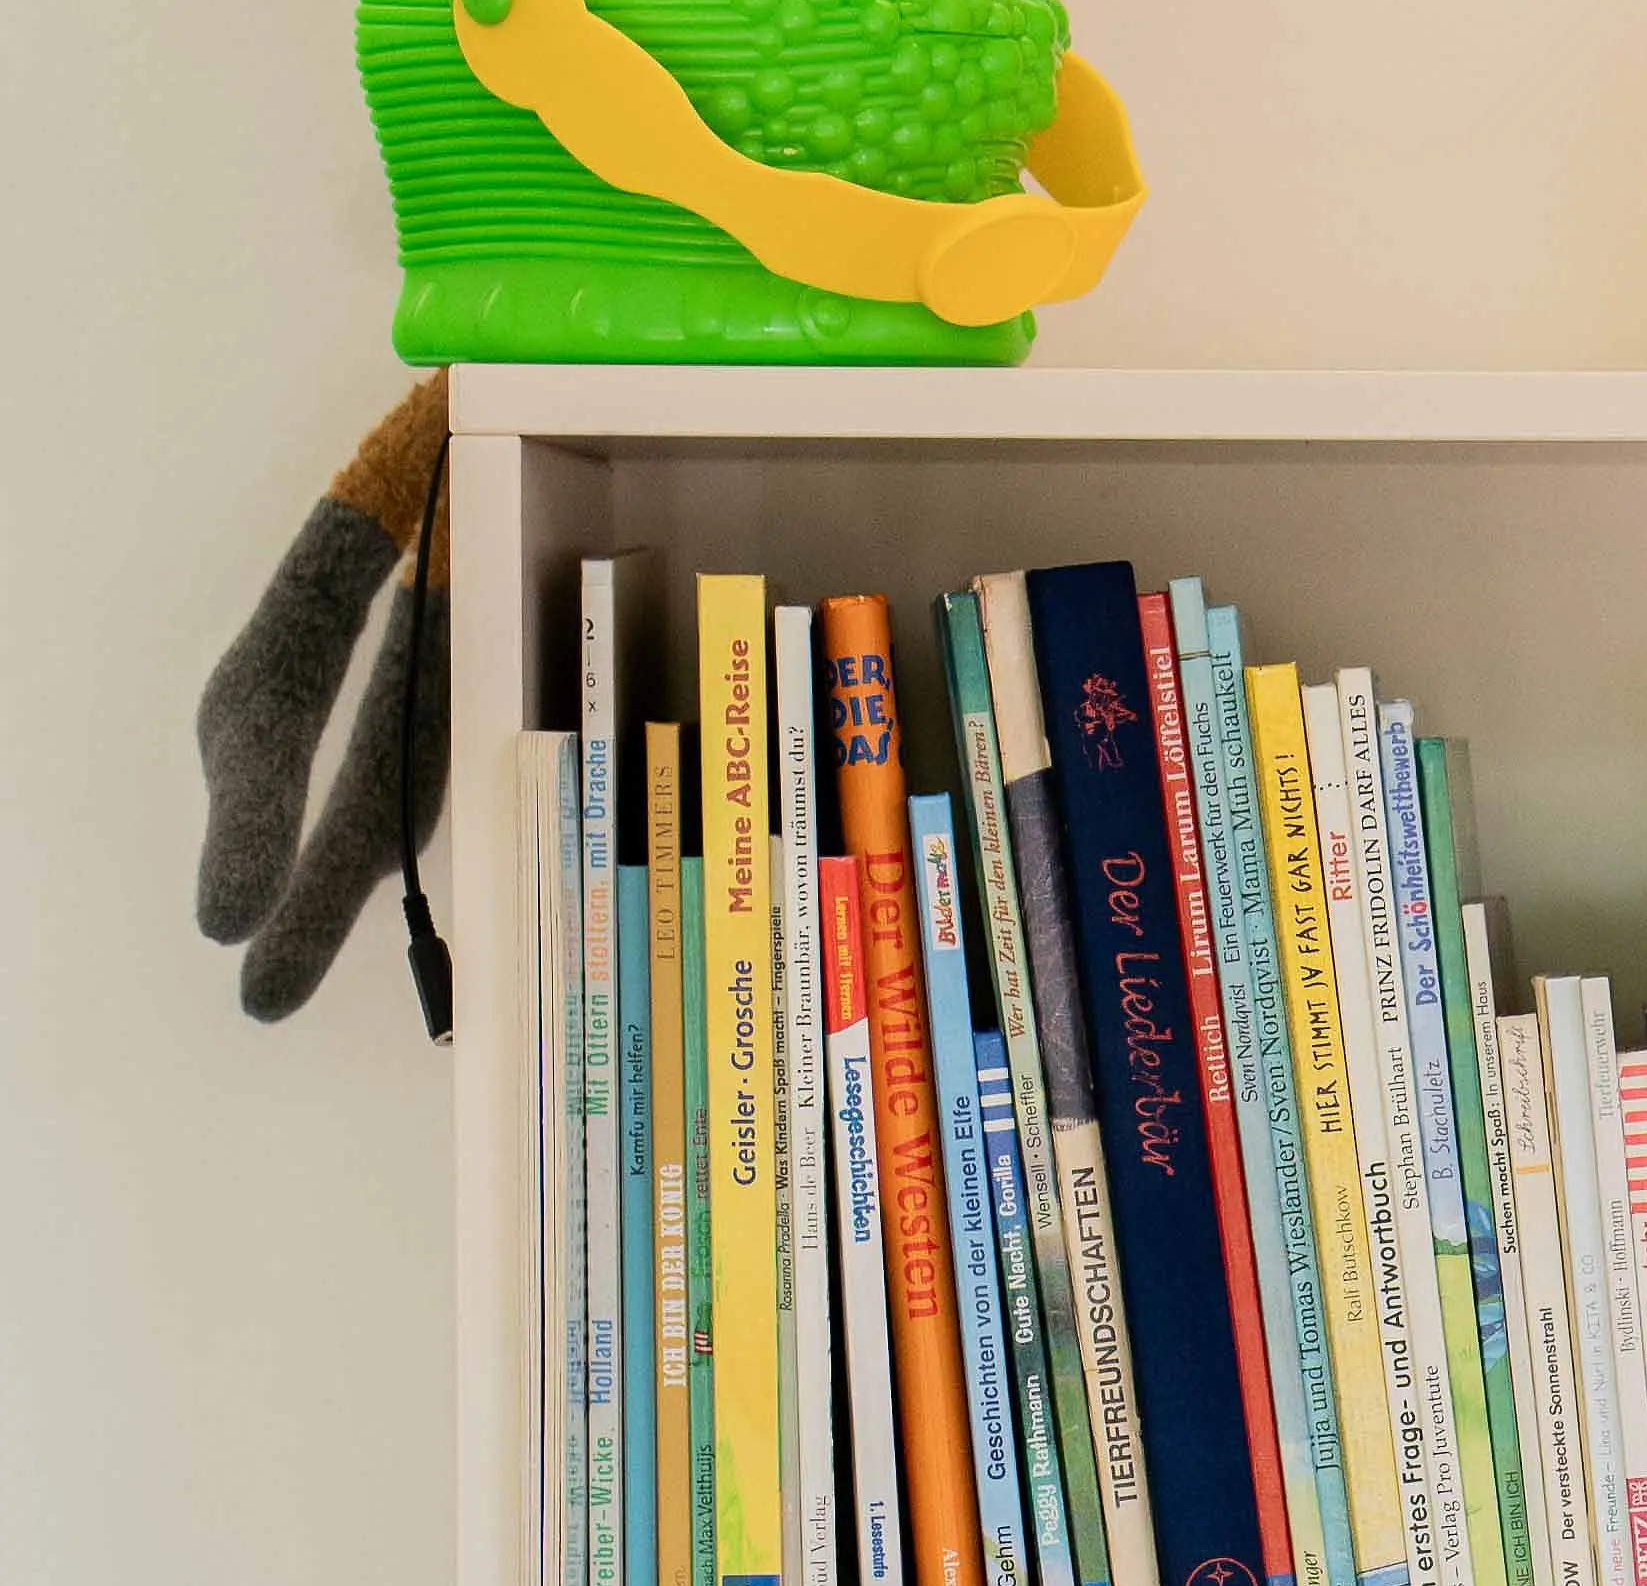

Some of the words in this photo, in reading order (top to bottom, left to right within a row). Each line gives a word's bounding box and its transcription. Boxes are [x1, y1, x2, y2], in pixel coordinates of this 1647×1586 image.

[725, 640, 751, 808] ABC-Reise
[831, 693, 893, 733] DIE,
[1149, 645, 1188, 782] Löffelstiel
[1191, 702, 1215, 757] Fuchs
[1347, 693, 1371, 764] ALLES
[585, 740, 606, 820] Drache
[1200, 762, 1221, 797] den
[1204, 801, 1225, 828] für
[1355, 769, 1379, 831] DARF
[586, 832, 607, 869] mit
[654, 765, 674, 896] TIMMERS
[727, 817, 753, 914] Meine
[1170, 791, 1204, 883] Larum
[1325, 830, 1353, 902] Ritter
[863, 852, 903, 951] Der
[1207, 831, 1237, 929] Feuerwerk
[1362, 837, 1392, 948] FRIDOLIN
[656, 909, 675, 959] LEO
[770, 907, 786, 991] Fingerspiele
[1181, 892, 1215, 975] Lirum
[1220, 933, 1241, 964] Ein
[729, 960, 755, 1071] Grosche
[1374, 954, 1400, 1023] PRINZ
[586, 994, 608, 1062] Ottern
[773, 1010, 786, 1053] macht
[876, 961, 923, 1117] Wilde
[1199, 1013, 1230, 1103] Rettich
[1590, 1010, 1617, 1120] Tierfeuerwehr
[586, 1079, 609, 1115] Mit
[774, 1058, 787, 1095] Spaß
[1018, 1074, 1042, 1150] Scheffler
[730, 1090, 757, 1185] Geisler
[775, 1098, 788, 1156] Kindern
[842, 1056, 875, 1244] Lesegeschichten
[951, 1096, 973, 1141] Elfe
[776, 1160, 790, 1190] Was
[957, 1148, 984, 1232] kleinen
[1030, 1164, 1052, 1230] Wensell
[777, 1203, 791, 1254] Pradella
[890, 1134, 938, 1321] Westen
[965, 1239, 989, 1279] der
[1364, 1161, 1403, 1330] Antwortbuch
[778, 1258, 792, 1311] Rosanna
[971, 1285, 993, 1329] von
[1070, 1165, 1139, 1509] TIERFREUNDSCHAFTEN
[1384, 1339, 1412, 1389] und
[1539, 1307, 1565, 1416] Sonnenstrahl
[973, 1335, 1008, 1481] Geschichten
[1023, 1374, 1052, 1479] Rathmann
[1395, 1398, 1429, 1484] Frage-
[1422, 1364, 1448, 1457] Juventute
[1437, 1462, 1455, 1495] Pro
[1550, 1421, 1572, 1506] versteckte
[809, 1495, 830, 1552] Verlag
[1034, 1483, 1061, 1546] Peggy
[1406, 1493, 1435, 1571] erstes
[1438, 1500, 1466, 1560] Verlag
[1558, 1510, 1577, 1540] Der
